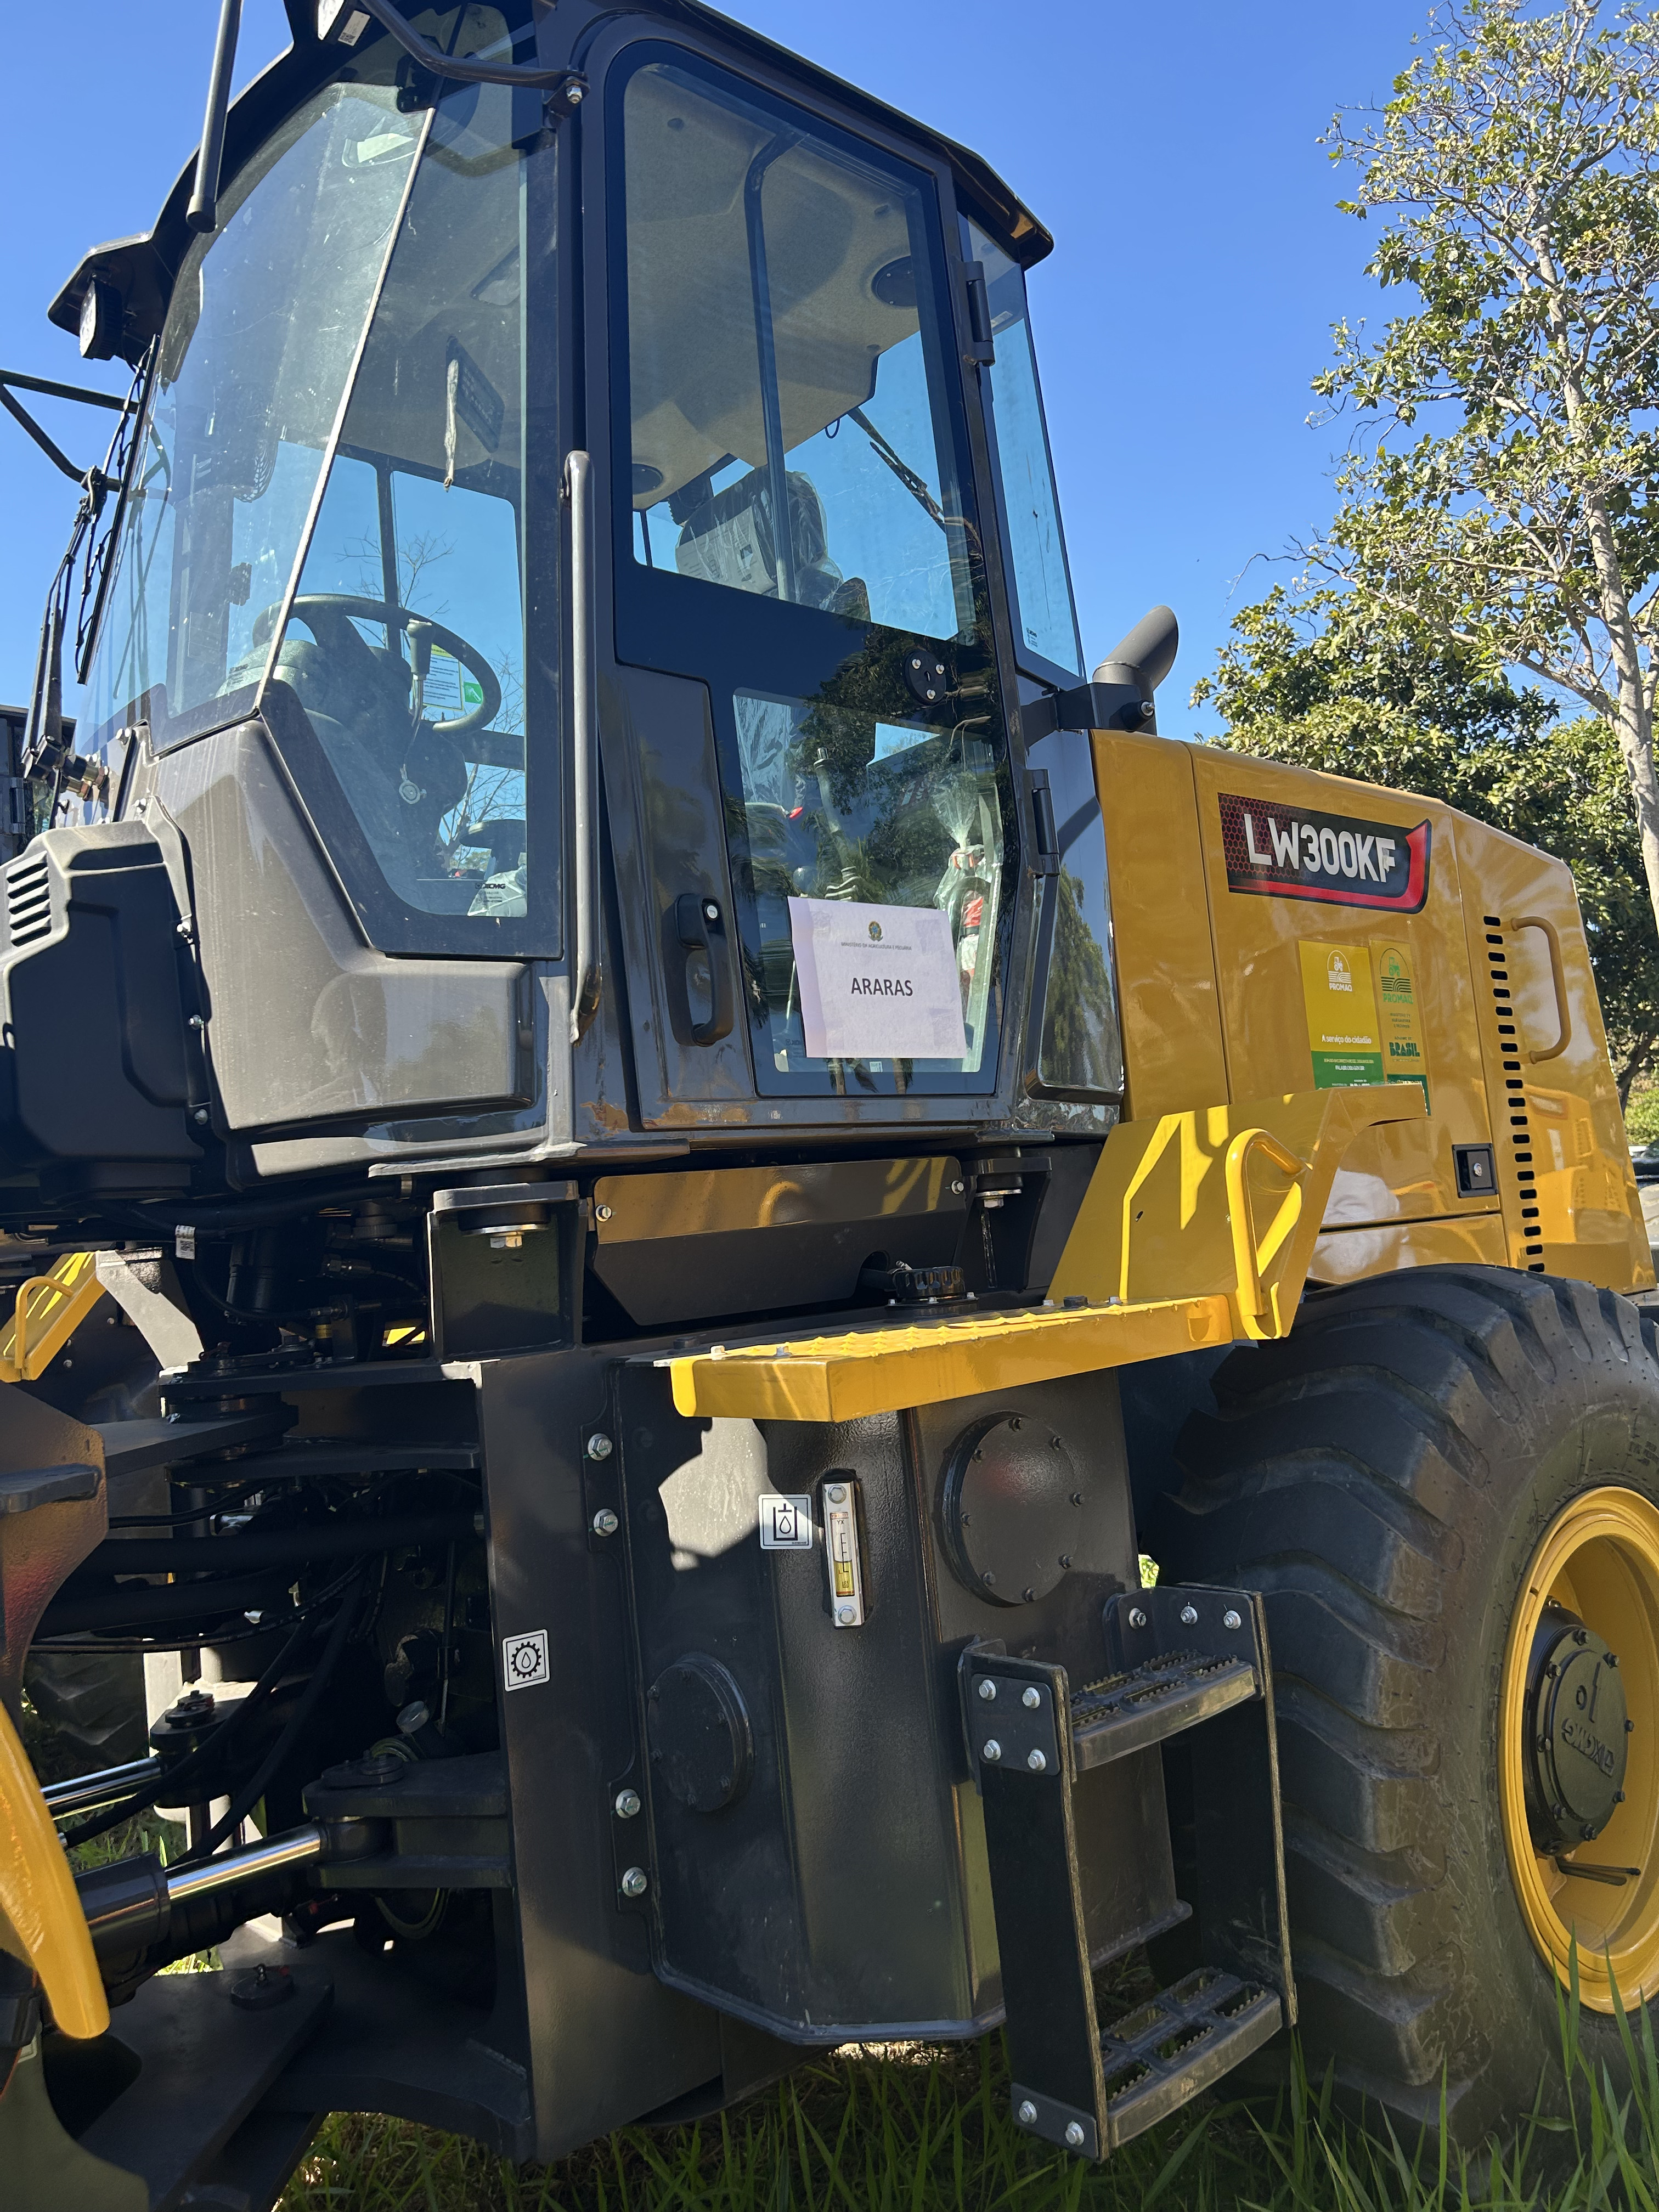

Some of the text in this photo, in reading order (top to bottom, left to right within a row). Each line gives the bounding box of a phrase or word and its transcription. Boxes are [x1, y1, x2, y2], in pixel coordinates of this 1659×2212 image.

[1244, 813, 1396, 883] LW300KF
[851, 978, 913, 996] ARARAS
[1329, 983, 1353, 992] PROMAQ
[1383, 993, 1413, 1004] PROMAQ
[1326, 1035, 1344, 1045] serviço
[1352, 1036, 1372, 1044] cidadão
[1389, 1042, 1420, 1057] BRASIL
[1561, 1718, 1605, 1767] XCMG
